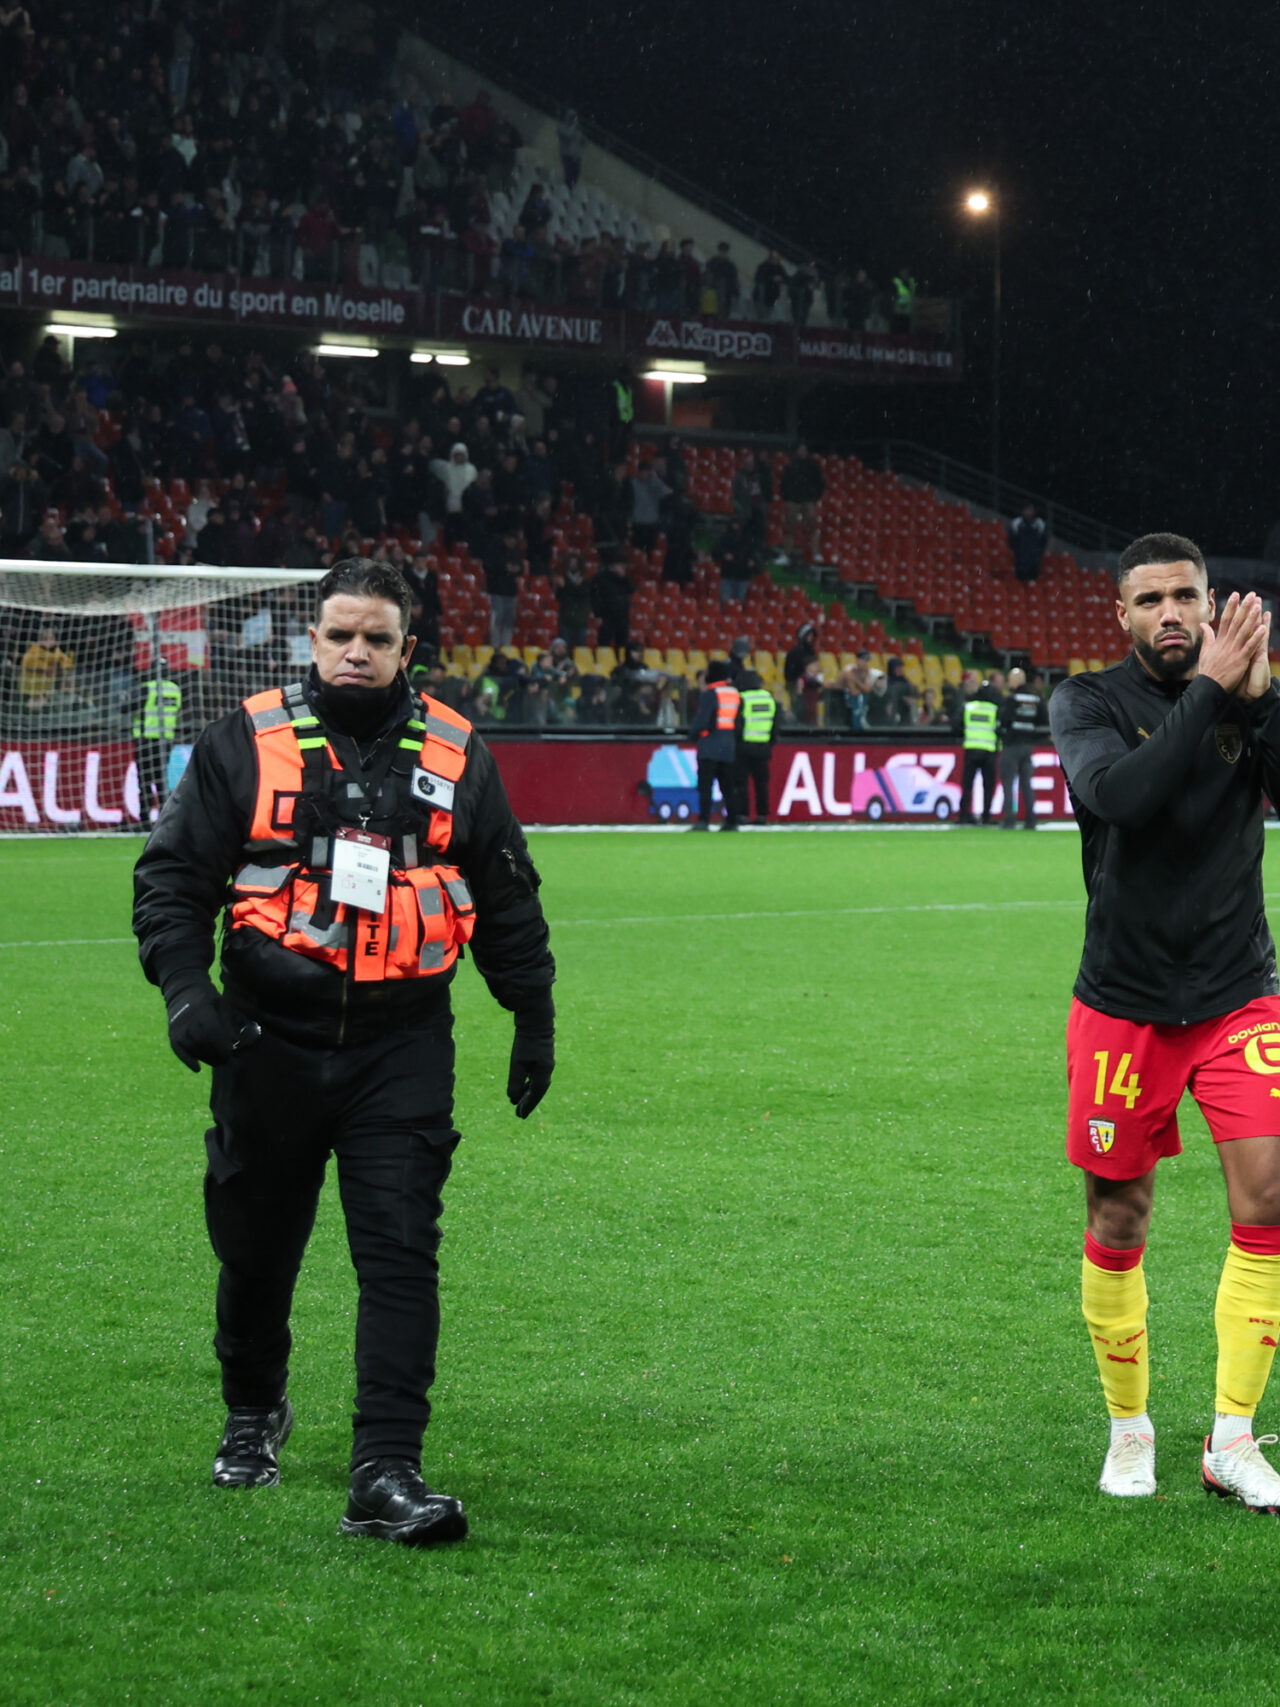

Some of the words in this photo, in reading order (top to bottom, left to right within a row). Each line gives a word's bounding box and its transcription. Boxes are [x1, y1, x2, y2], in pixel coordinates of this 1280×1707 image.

[29, 268, 66, 295] 1er
[72, 276, 188, 305] partenaire
[194, 281, 223, 308] du
[229, 289, 286, 317] sport
[291, 296, 318, 316] en
[324, 292, 406, 324] Moselle
[462, 304, 513, 337] CAR
[516, 311, 602, 344] AVENUE
[680, 321, 773, 359] Kappa
[1093, 1050, 1142, 1109] 14
